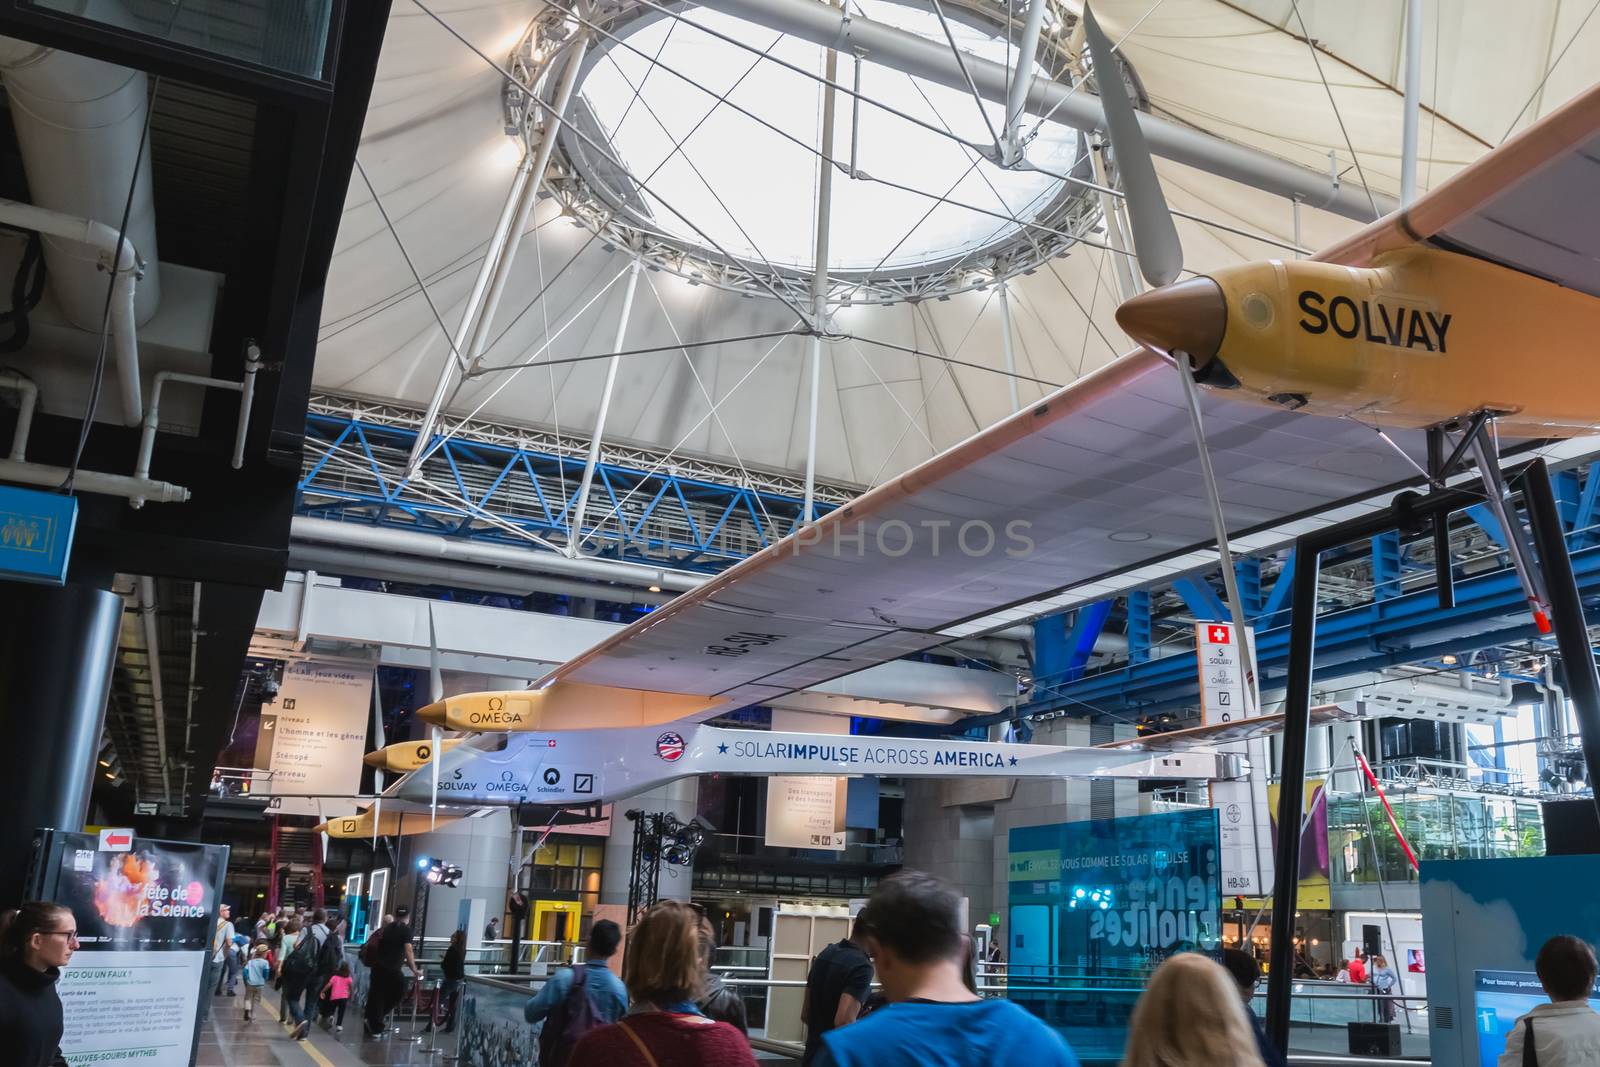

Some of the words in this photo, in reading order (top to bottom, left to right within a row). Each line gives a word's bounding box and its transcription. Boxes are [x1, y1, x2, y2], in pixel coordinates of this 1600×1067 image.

[1298, 290, 1452, 353] SOLVAY
[1209, 657, 1233, 665] SOLVAY
[1211, 677, 1234, 685] OMEGA
[470, 712, 522, 724] OMEGA
[326, 730, 339, 739] les
[864, 748, 929, 765] ACROSS
[933, 751, 1005, 768] AMERICA
[437, 782, 477, 791] SOLVAY
[486, 782, 528, 792] OMEGA
[1081, 856, 1109, 868] COMME
[1110, 855, 1120, 866] LE
[1121, 854, 1149, 866] SOLAR
[1227, 877, 1251, 889] HB-SIA
[171, 885, 188, 901] de
[136, 902, 148, 917] la
[151, 901, 205, 918] Science
[81, 971, 94, 979] OU
[95, 970, 107, 978] UN
[107, 970, 128, 978] FAUX
[128, 1049, 158, 1058] MYTHES
